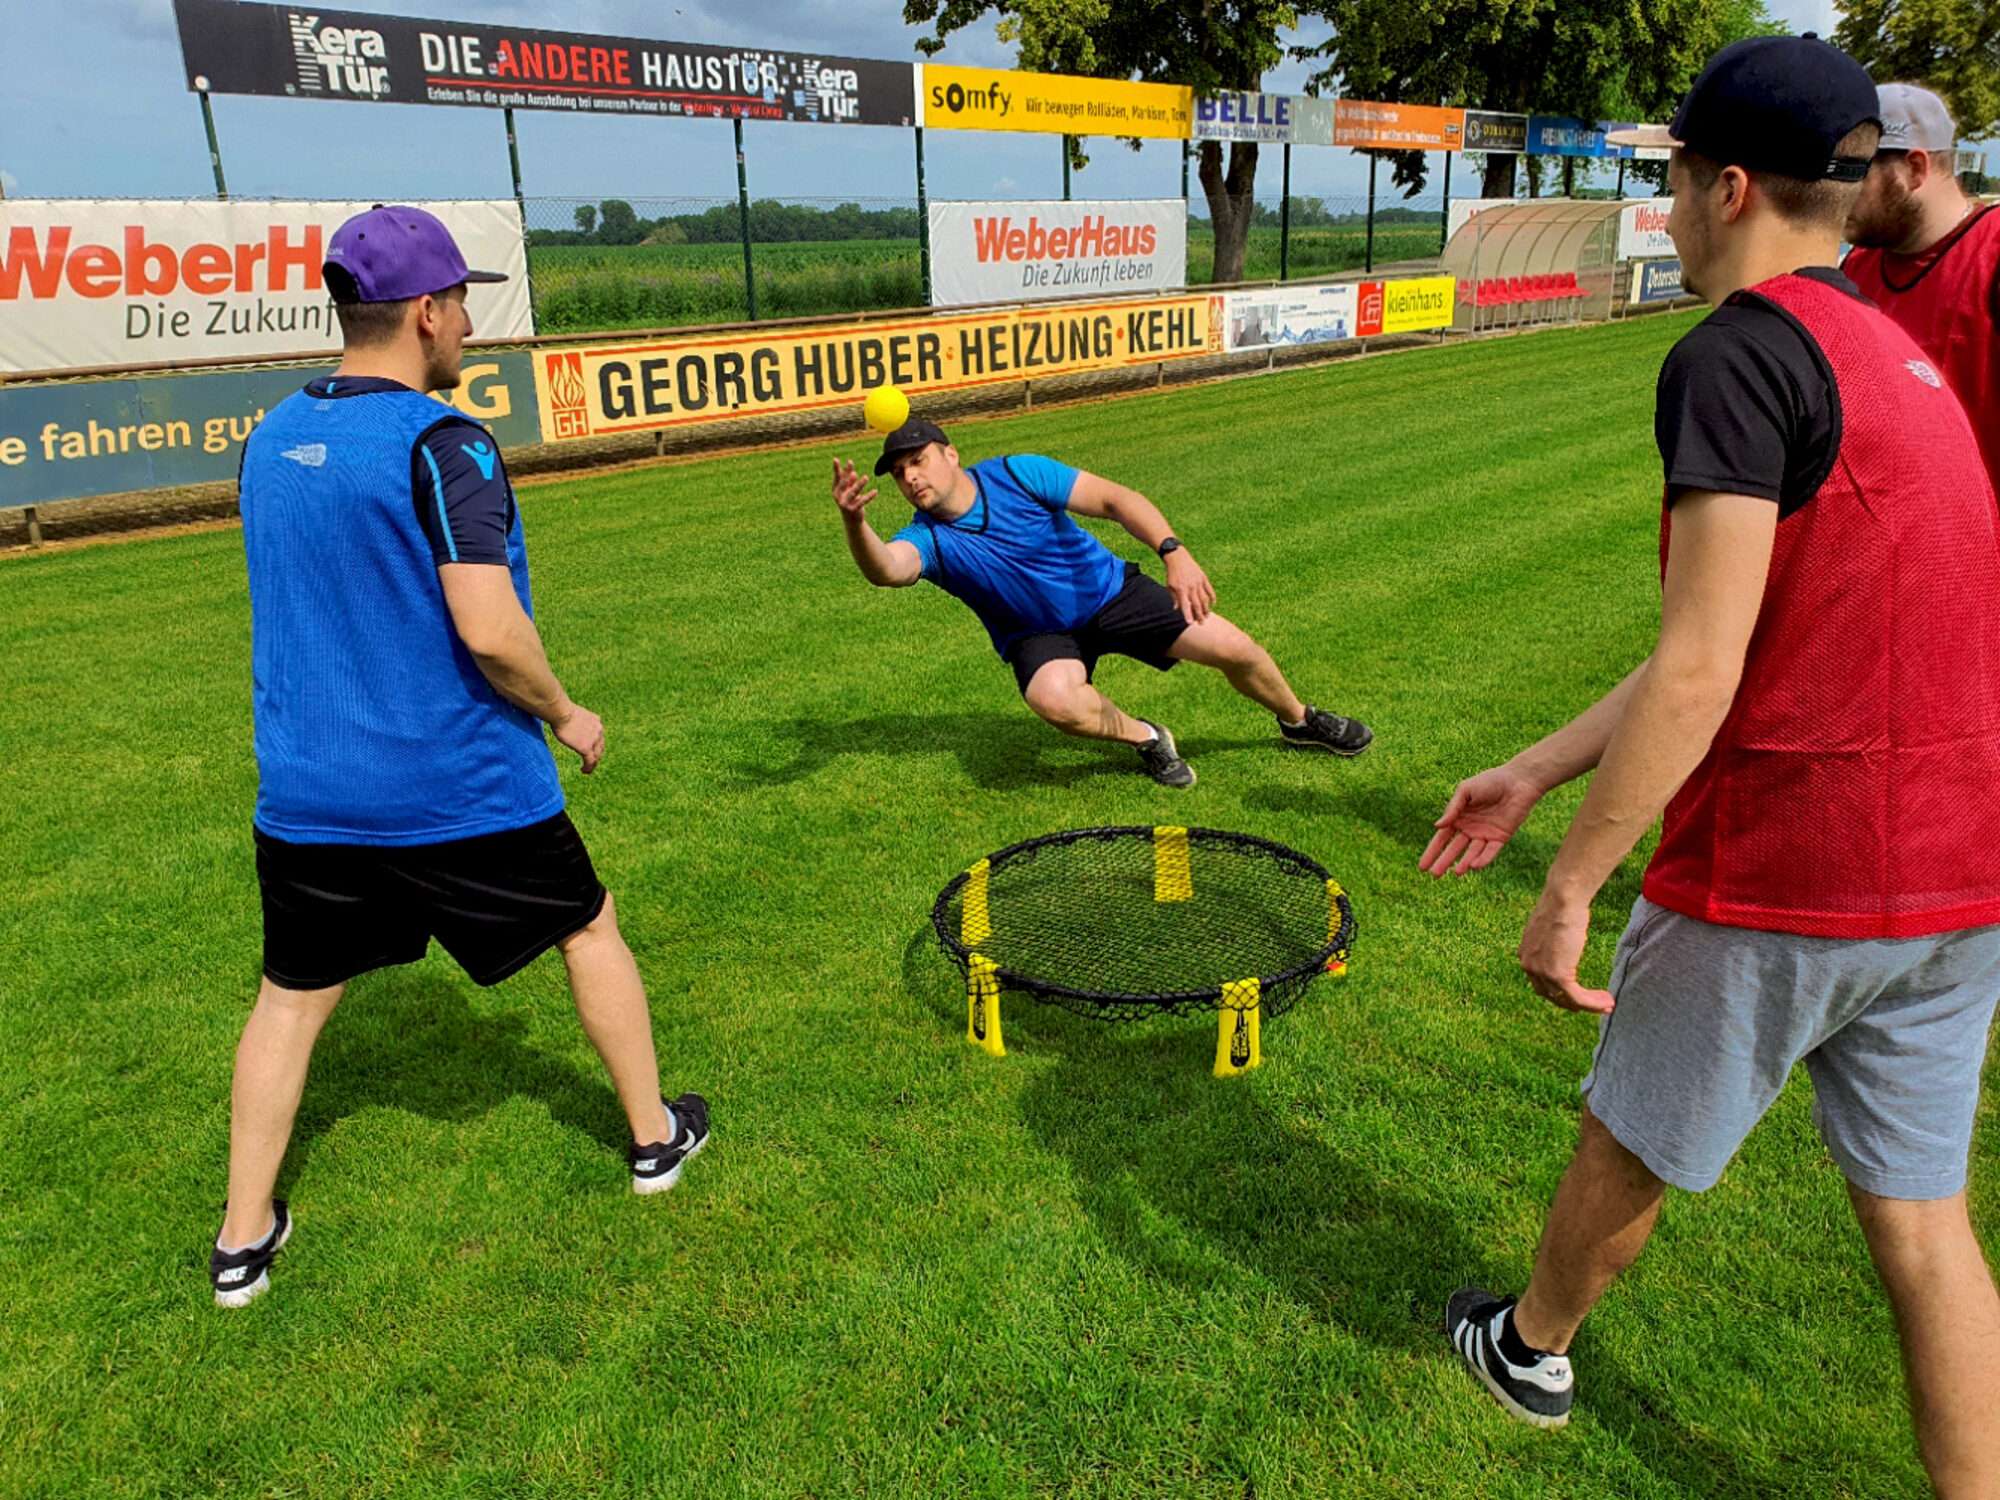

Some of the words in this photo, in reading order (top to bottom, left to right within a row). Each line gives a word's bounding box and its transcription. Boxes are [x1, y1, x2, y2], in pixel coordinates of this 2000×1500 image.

[288, 13, 386, 58] Kera
[420, 33, 482, 74] DIE
[498, 40, 632, 85] ANDERE
[803, 59, 858, 92] Kera
[428, 87, 464, 101] Erleben
[465, 89, 481, 102] Sie
[483, 90, 497, 103] die
[579, 96, 592, 108] bei
[932, 81, 1012, 116] somfy
[1026, 98, 1042, 113] Wir
[1045, 100, 1084, 118] bewegen
[1197, 93, 1290, 125] BELLE
[974, 215, 1157, 263] WeberHaus
[0, 225, 322, 300] WeberH
[1022, 265, 1048, 287] Die
[1053, 261, 1112, 287] Zukunft
[1114, 259, 1153, 281] leben
[126, 303, 190, 339] Die
[206, 296, 337, 338] Zukunf
[1388, 288, 1443, 313] kleinhans
[598, 348, 784, 420] GEORG
[794, 332, 942, 398] HUBER
[960, 315, 1113, 376] HEIZUNG
[1128, 307, 1203, 354] KEHL
[430, 363, 511, 419] G
[40, 419, 192, 461] fahren
[556, 413, 587, 437] GH
